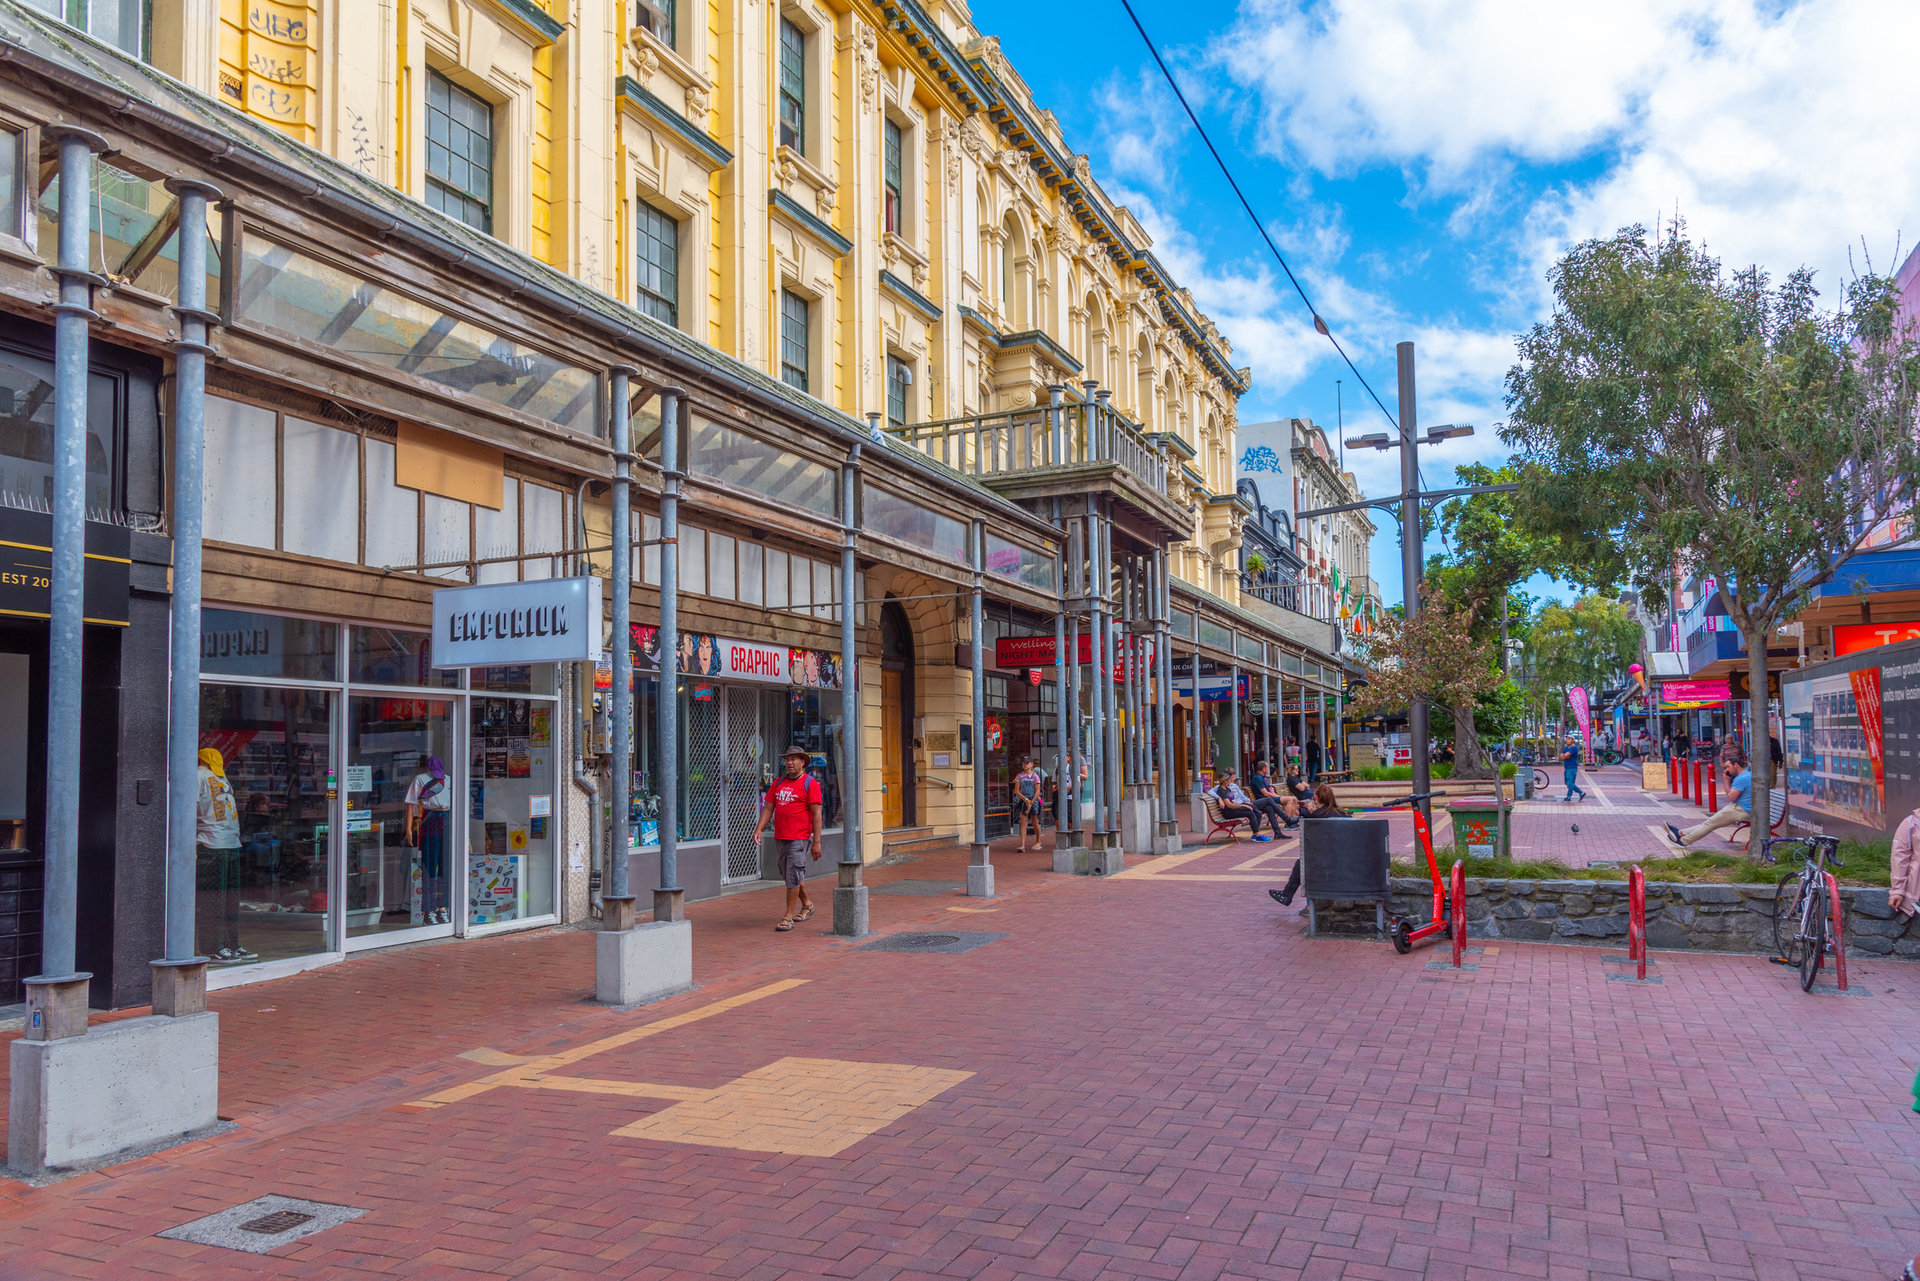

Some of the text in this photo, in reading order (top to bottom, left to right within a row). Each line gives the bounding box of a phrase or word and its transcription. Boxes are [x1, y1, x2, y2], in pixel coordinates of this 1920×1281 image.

[2, 572, 28, 585] EST
[450, 603, 570, 643] EMPORIUM
[1000, 650, 1034, 660] NIGHT
[730, 646, 780, 677] GRAPHIC
[1662, 683, 1696, 692] Wellington
[1394, 749, 1409, 758] $10
[778, 790, 792, 802] NZ
